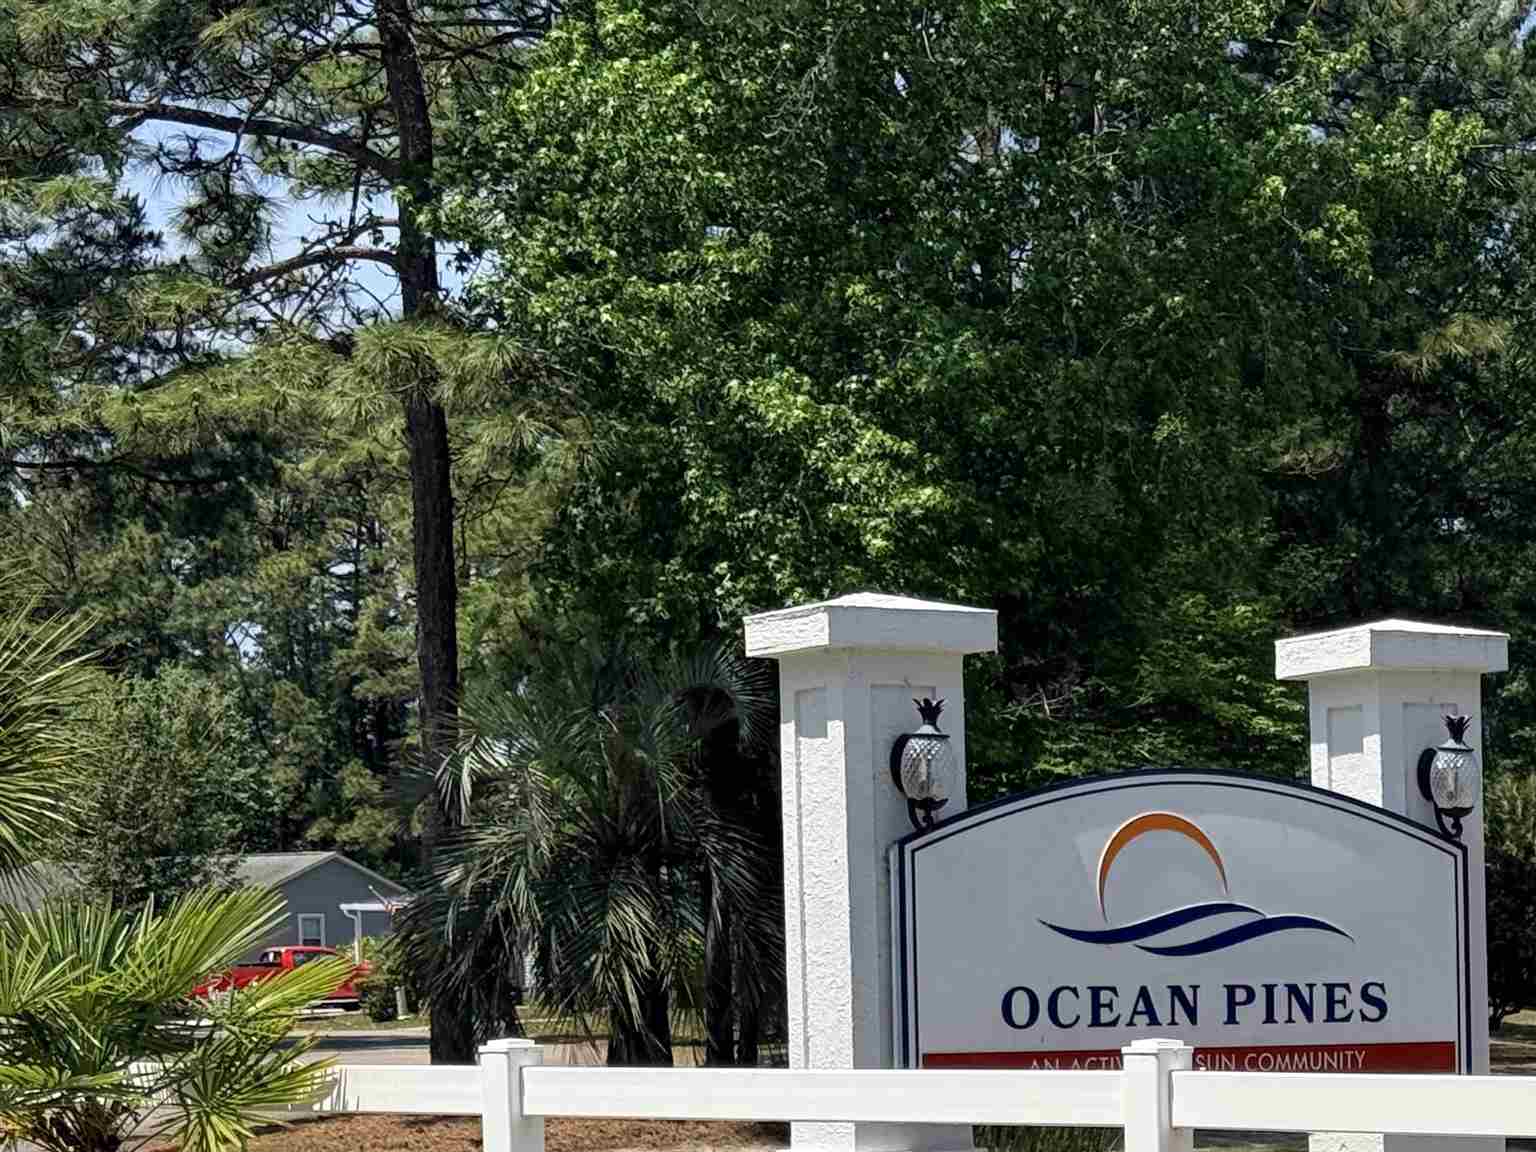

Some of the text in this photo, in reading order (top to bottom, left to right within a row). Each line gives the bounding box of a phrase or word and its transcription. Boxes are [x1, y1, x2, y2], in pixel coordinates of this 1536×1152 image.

[1001, 982, 1388, 1029] OCEAN PINES
[1195, 1053, 1236, 1071] SUN
[1245, 1050, 1367, 1071] COMMUNITY
